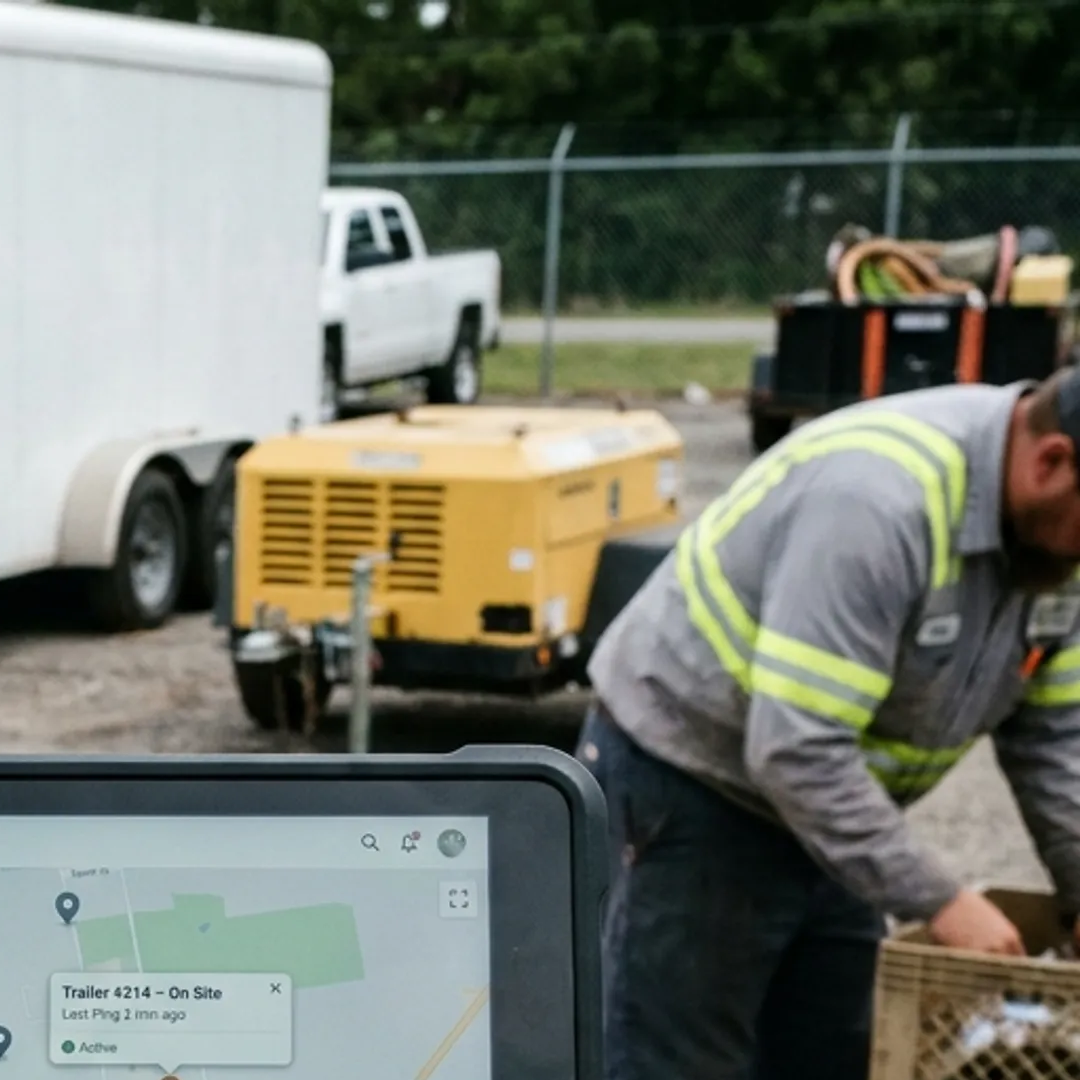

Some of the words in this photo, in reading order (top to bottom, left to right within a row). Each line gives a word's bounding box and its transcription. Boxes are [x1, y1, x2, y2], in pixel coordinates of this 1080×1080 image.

[62, 985, 110, 1000] Trailer
[114, 985, 152, 1000] 4214
[168, 986, 190, 1001] On
[193, 986, 223, 1001] Site
[162, 1010, 187, 1024] ago
[78, 1041, 118, 1054] Active
